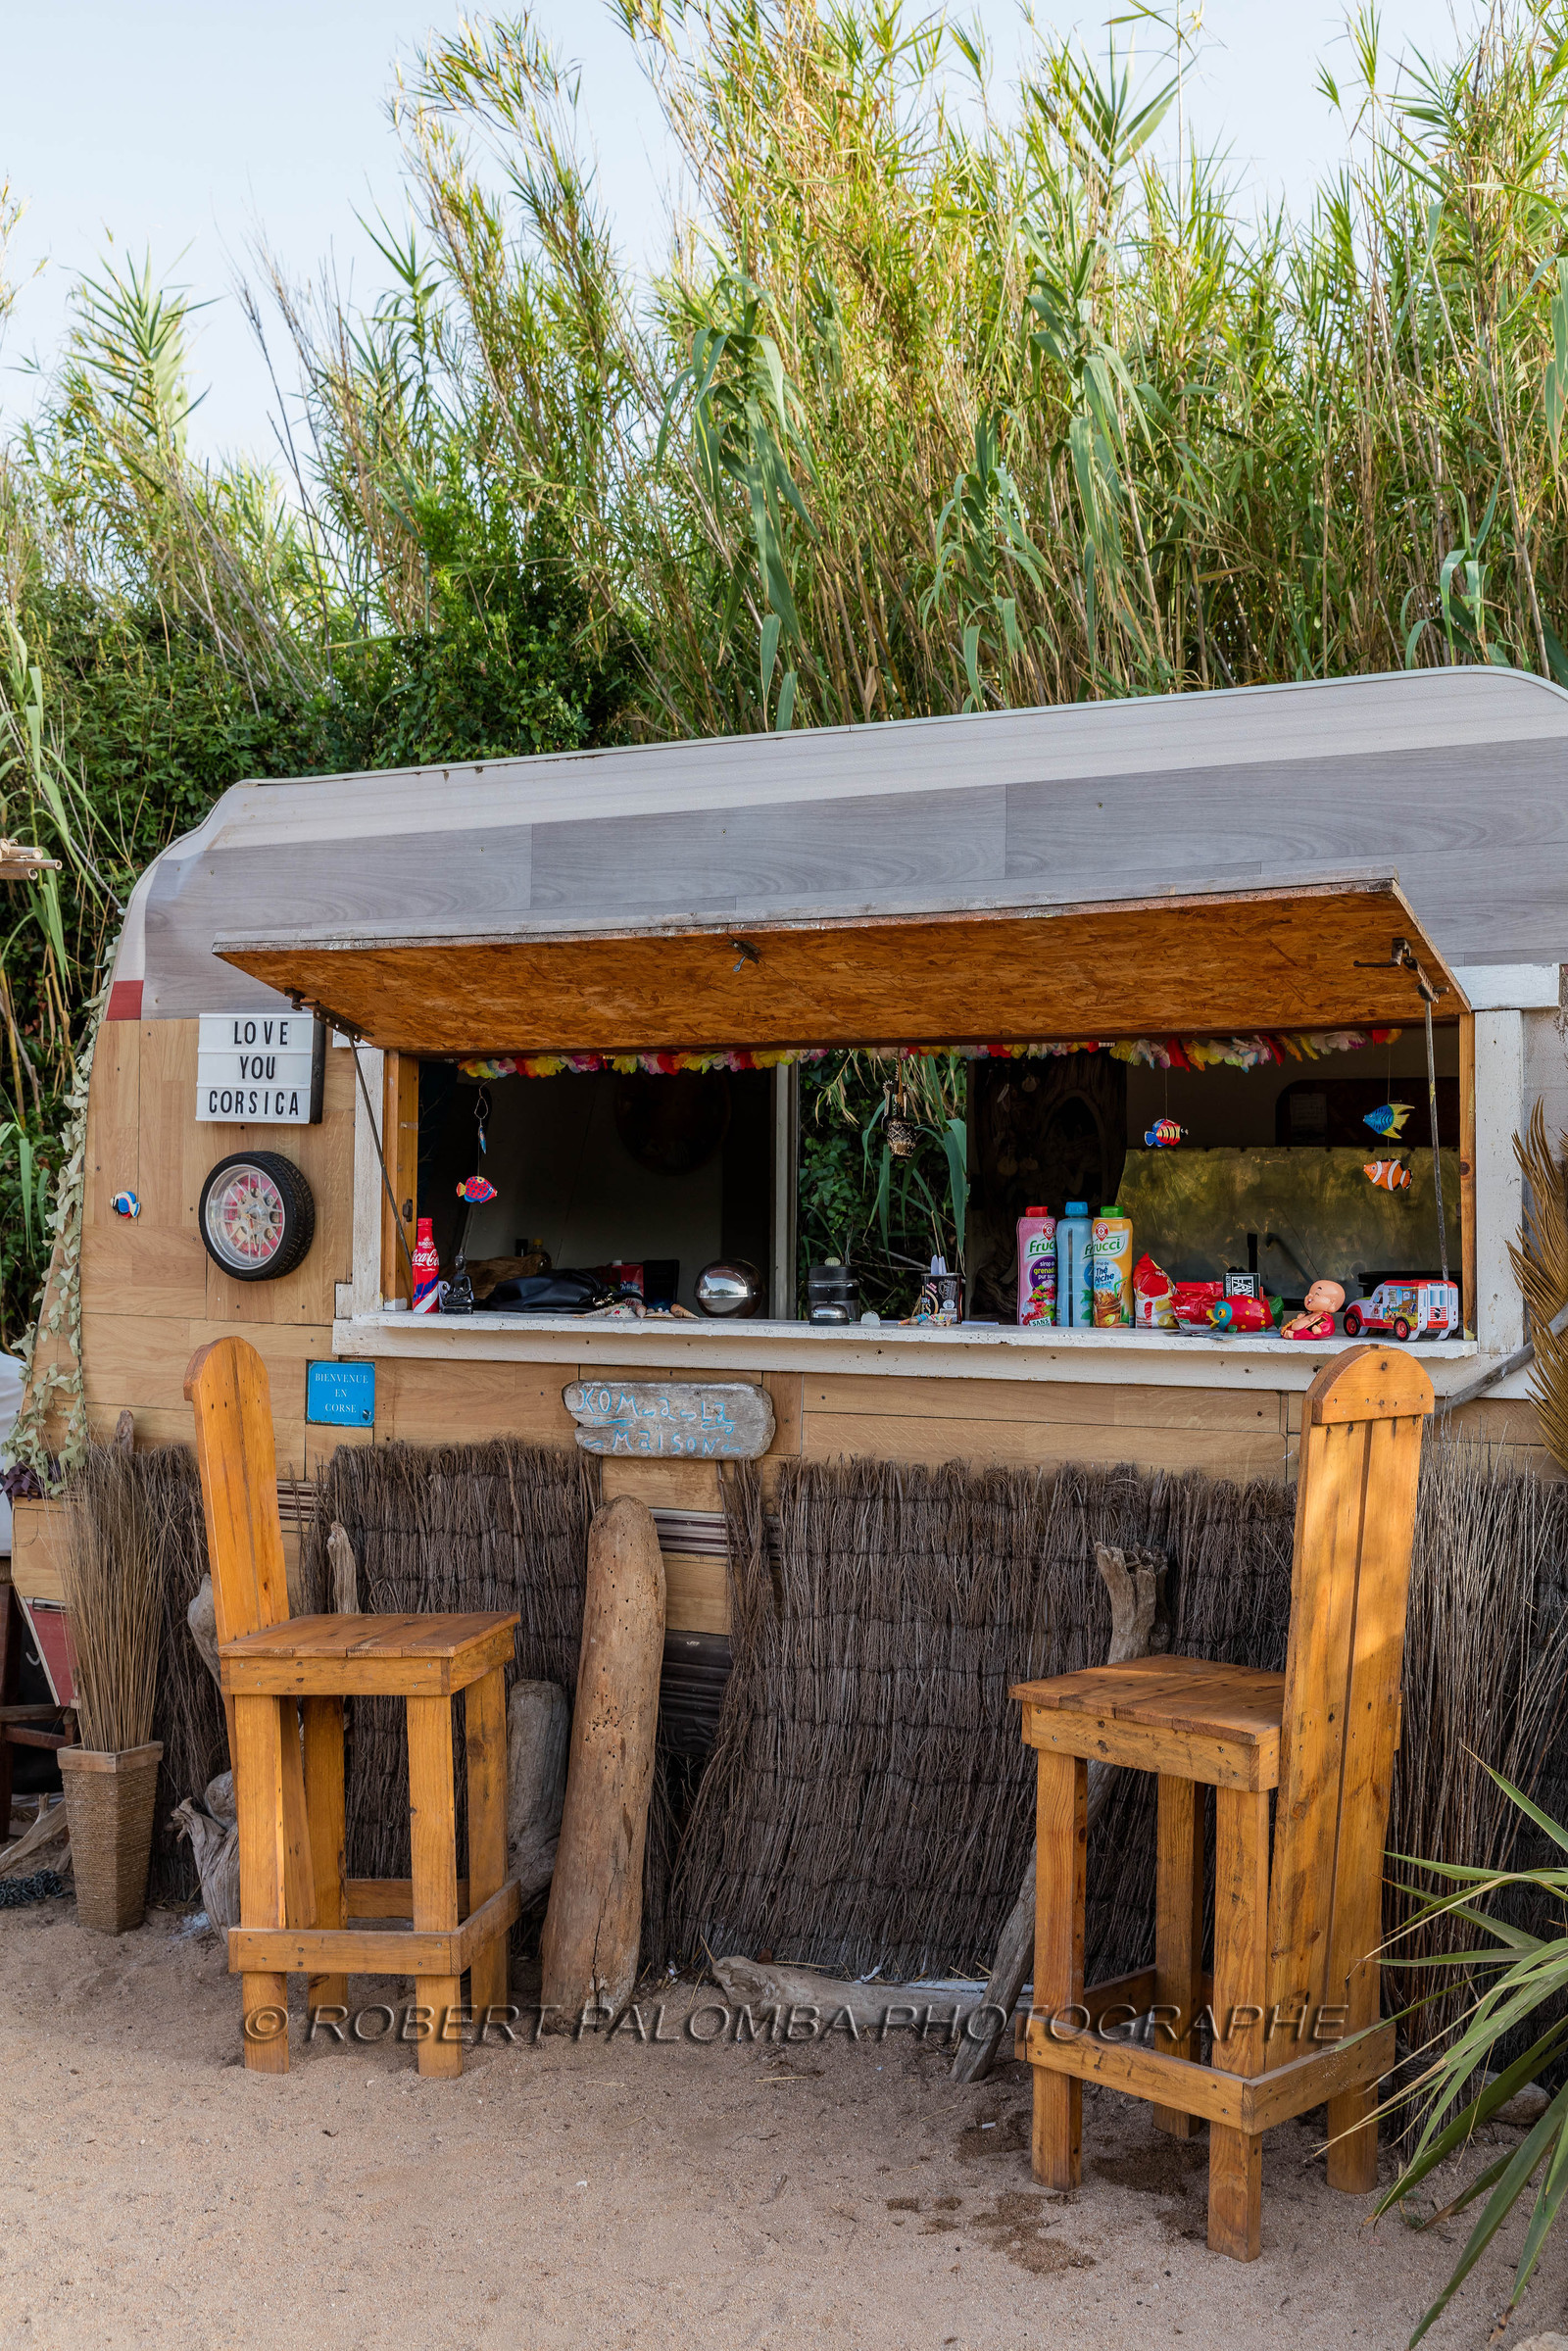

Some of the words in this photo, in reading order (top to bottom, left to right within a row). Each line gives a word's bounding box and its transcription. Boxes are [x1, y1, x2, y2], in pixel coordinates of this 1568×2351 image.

[233, 1020, 289, 1046] LOVE
[239, 1055, 275, 1080] YOU
[208, 1090, 299, 1115] CORSICA
[1029, 1240, 1054, 1253] Fruc
[1033, 1267, 1056, 1276] grenad
[315, 1373, 368, 1384] BIENVENUE
[334, 1389, 348, 1397] EN
[324, 1402, 357, 1413] CORSE
